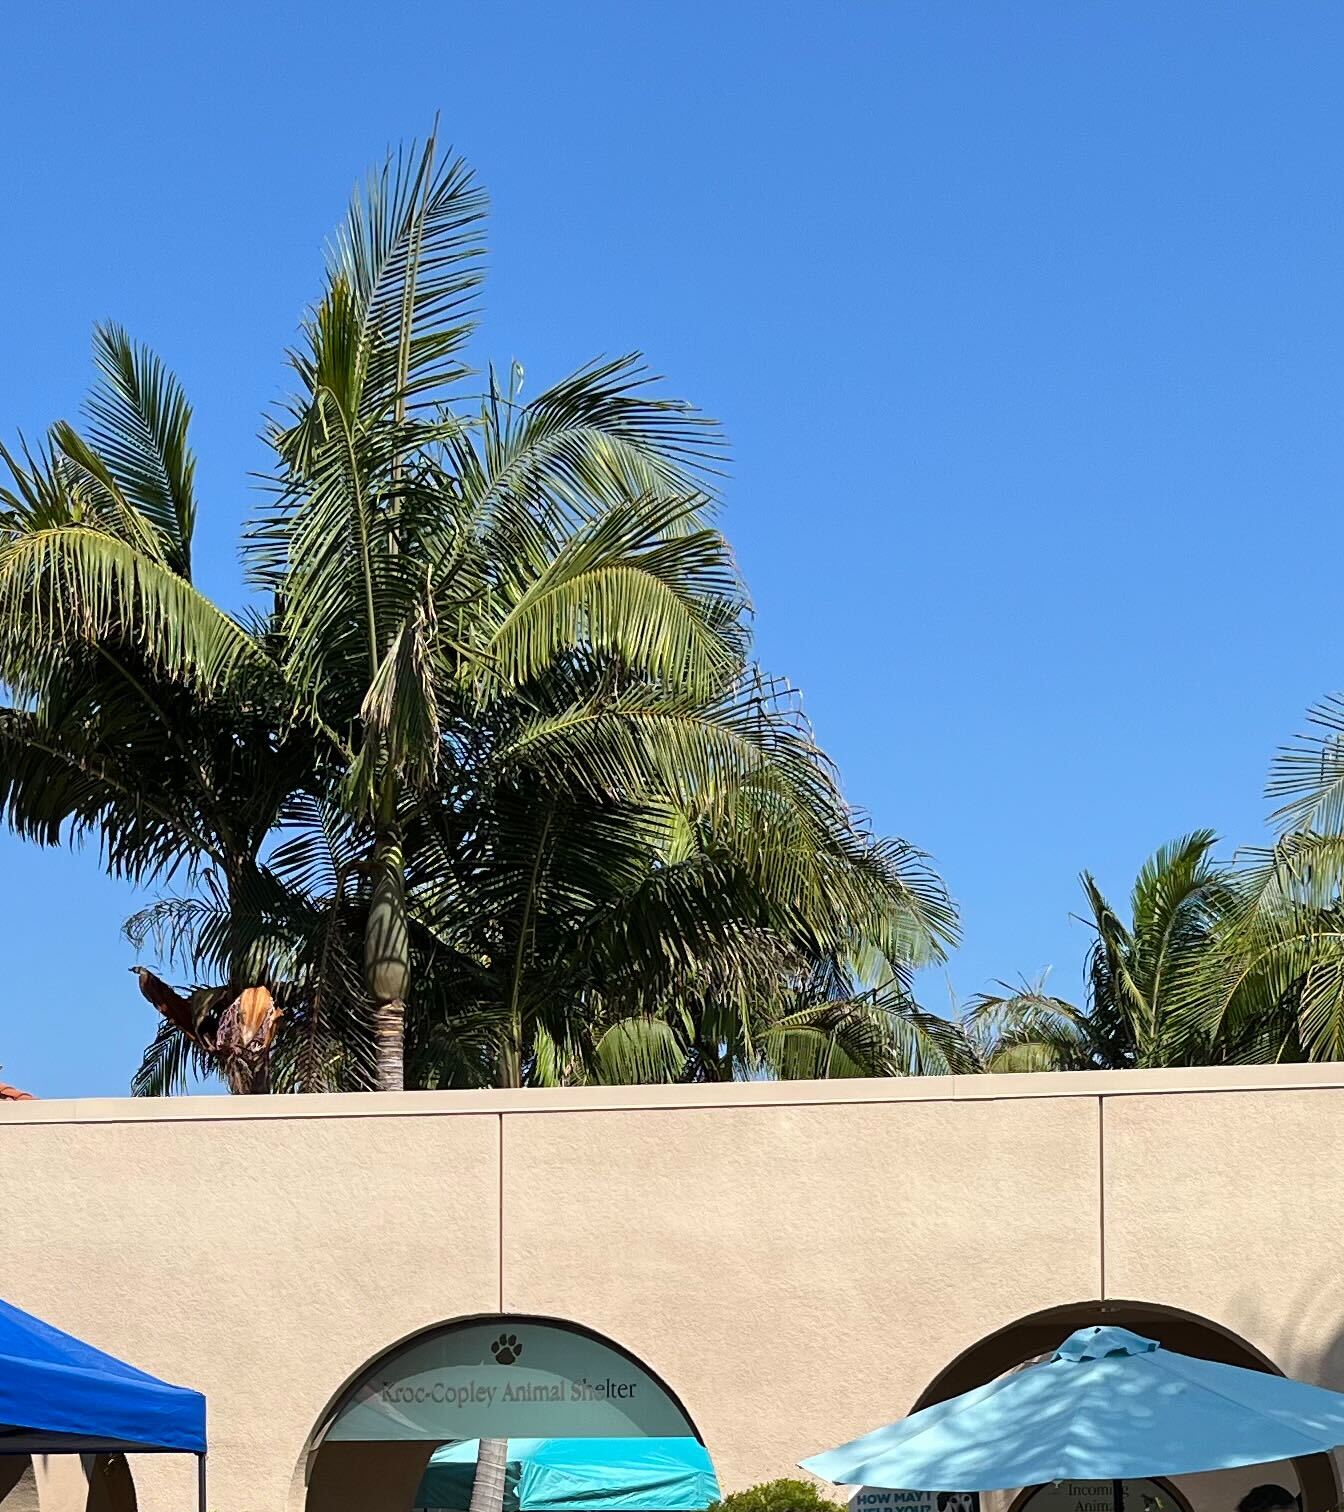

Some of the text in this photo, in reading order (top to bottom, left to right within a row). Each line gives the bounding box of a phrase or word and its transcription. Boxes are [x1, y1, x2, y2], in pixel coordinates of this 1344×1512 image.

[382, 1378, 637, 1408] Kroc-Copley Animal Shelter
[1068, 1484, 1129, 1497] Incomig
[857, 1493, 891, 1505] HOW
[896, 1491, 924, 1502] MAY
